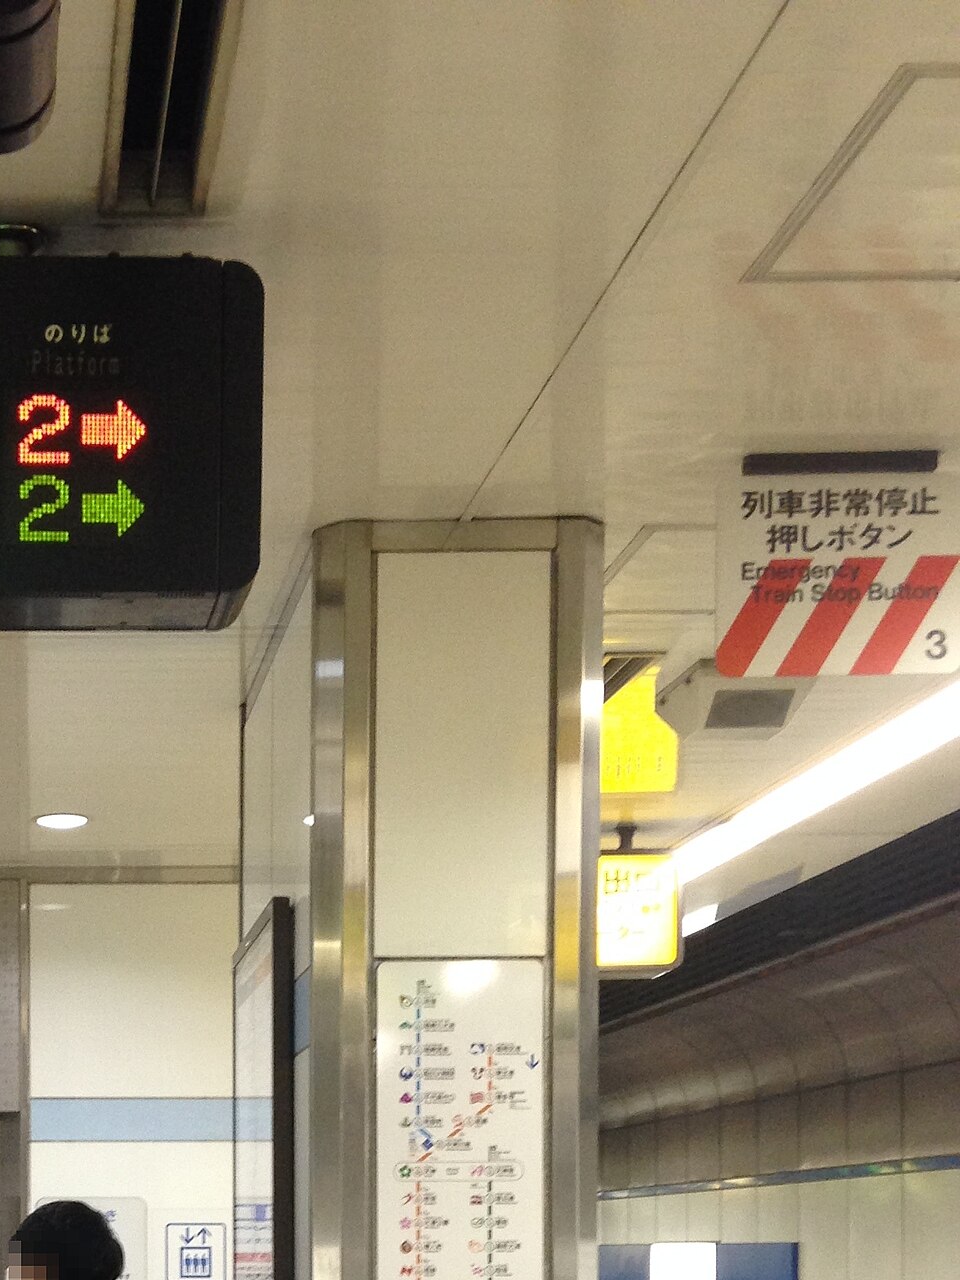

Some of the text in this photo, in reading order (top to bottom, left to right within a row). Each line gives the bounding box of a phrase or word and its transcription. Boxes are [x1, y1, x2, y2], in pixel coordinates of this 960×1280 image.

[44, 323, 113, 344] のりば
[17, 393, 71, 465] 2
[18, 474, 70, 543] 2
[741, 486, 940, 520] 列車非常停止
[765, 522, 914, 554] 押しボタン
[741, 560, 861, 584] Emergency
[751, 581, 940, 606] Train Stop Button
[924, 629, 949, 661] 3
